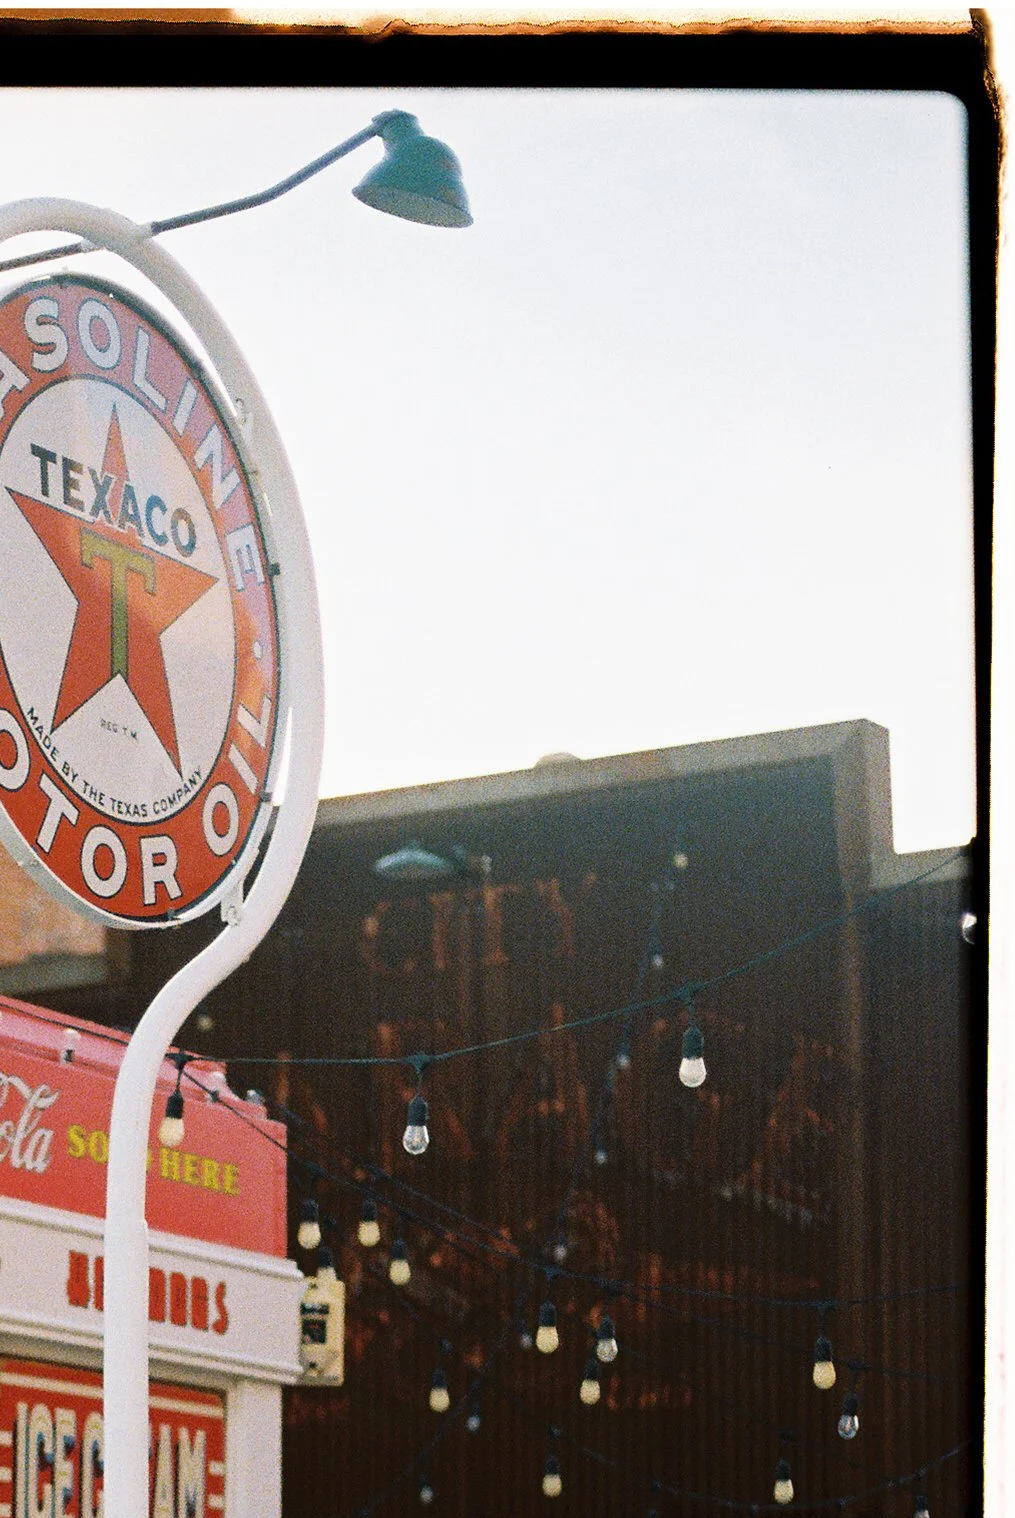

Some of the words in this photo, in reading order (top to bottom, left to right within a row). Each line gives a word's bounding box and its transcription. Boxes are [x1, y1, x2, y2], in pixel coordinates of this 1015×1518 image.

[30, 442, 198, 558] TEXACO
[80, 527, 156, 680] T
[26, 706, 60, 762] MADE
[61, 761, 79, 784] BY
[83, 780, 106, 806] THE
[110, 797, 149, 818] TEXAS
[152, 768, 203, 815] COMPANY
[201, 695, 272, 858] OIL
[159, 1147, 241, 1197] HERE
